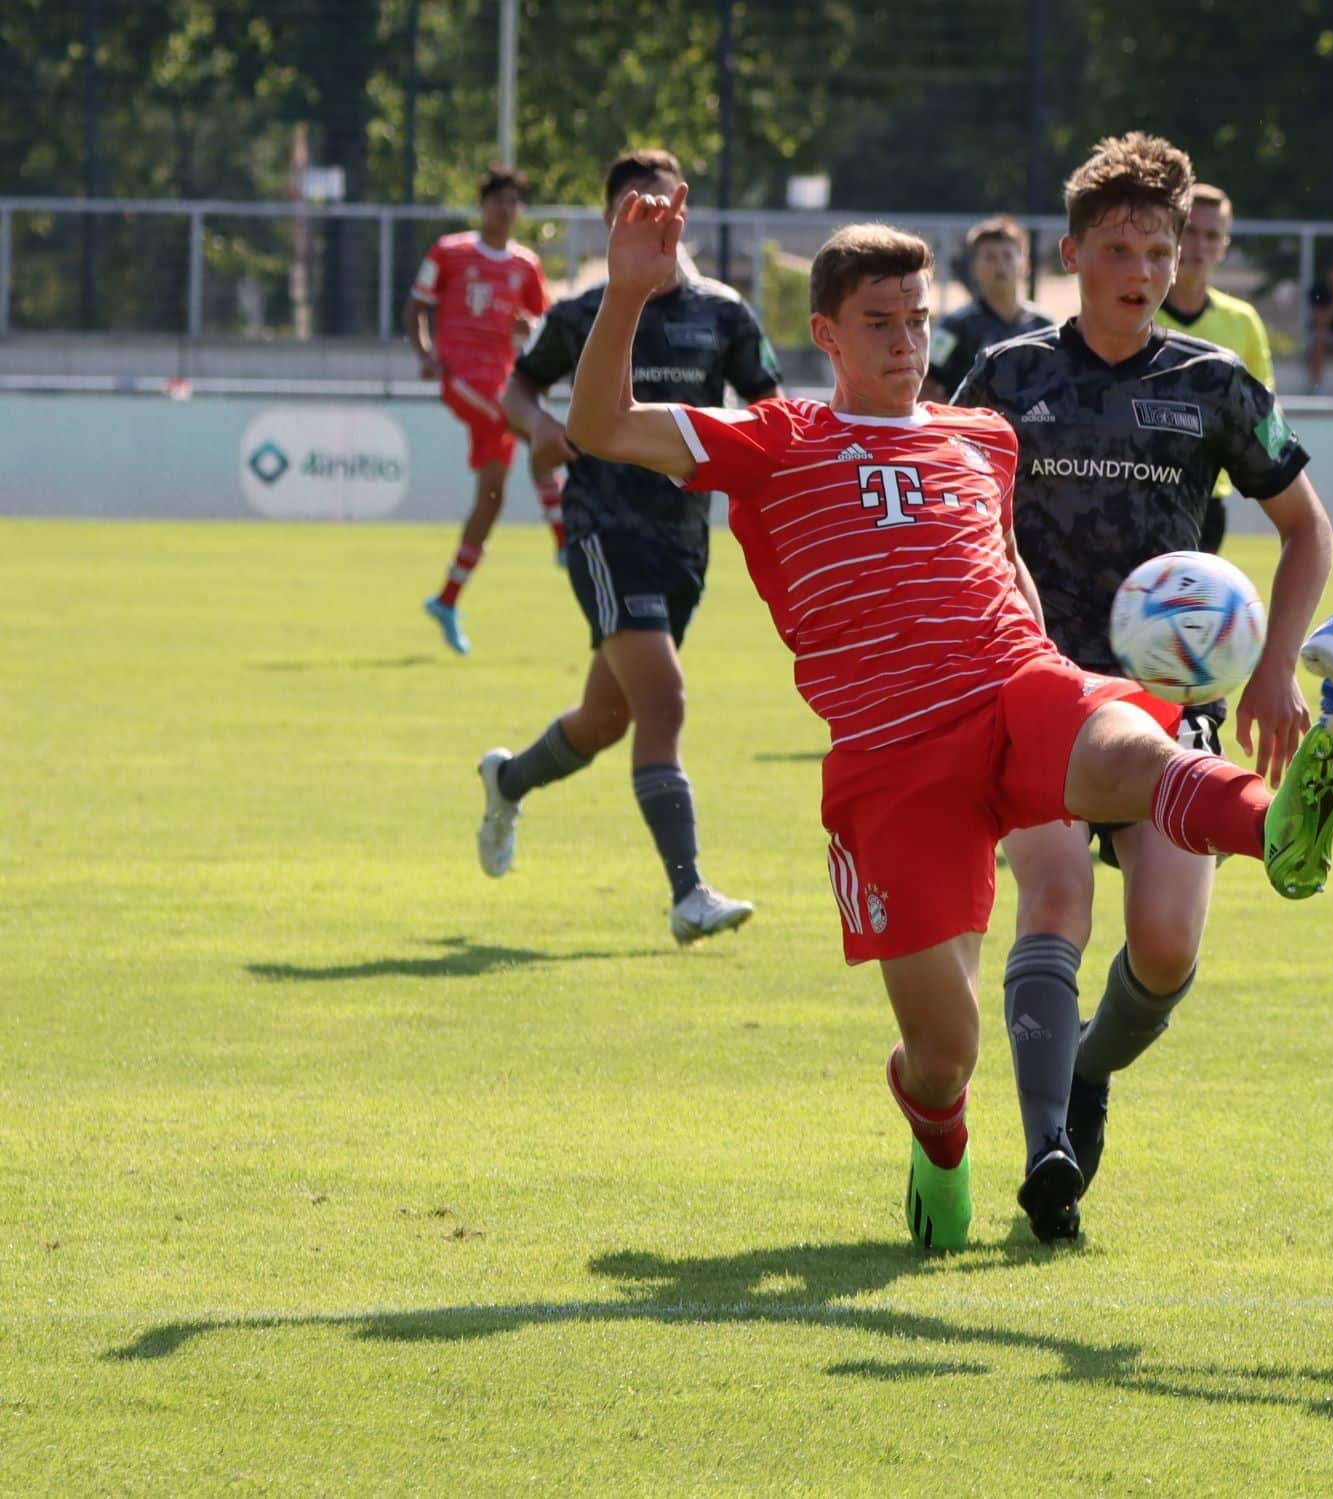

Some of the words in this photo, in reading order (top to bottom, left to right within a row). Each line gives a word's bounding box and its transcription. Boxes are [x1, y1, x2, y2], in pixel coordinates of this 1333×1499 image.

[632, 367, 707, 383] UNDTOWN
[837, 451, 874, 461] adidas
[1031, 458, 1183, 485] AROUNDTOWN
[858, 465, 925, 528] T
